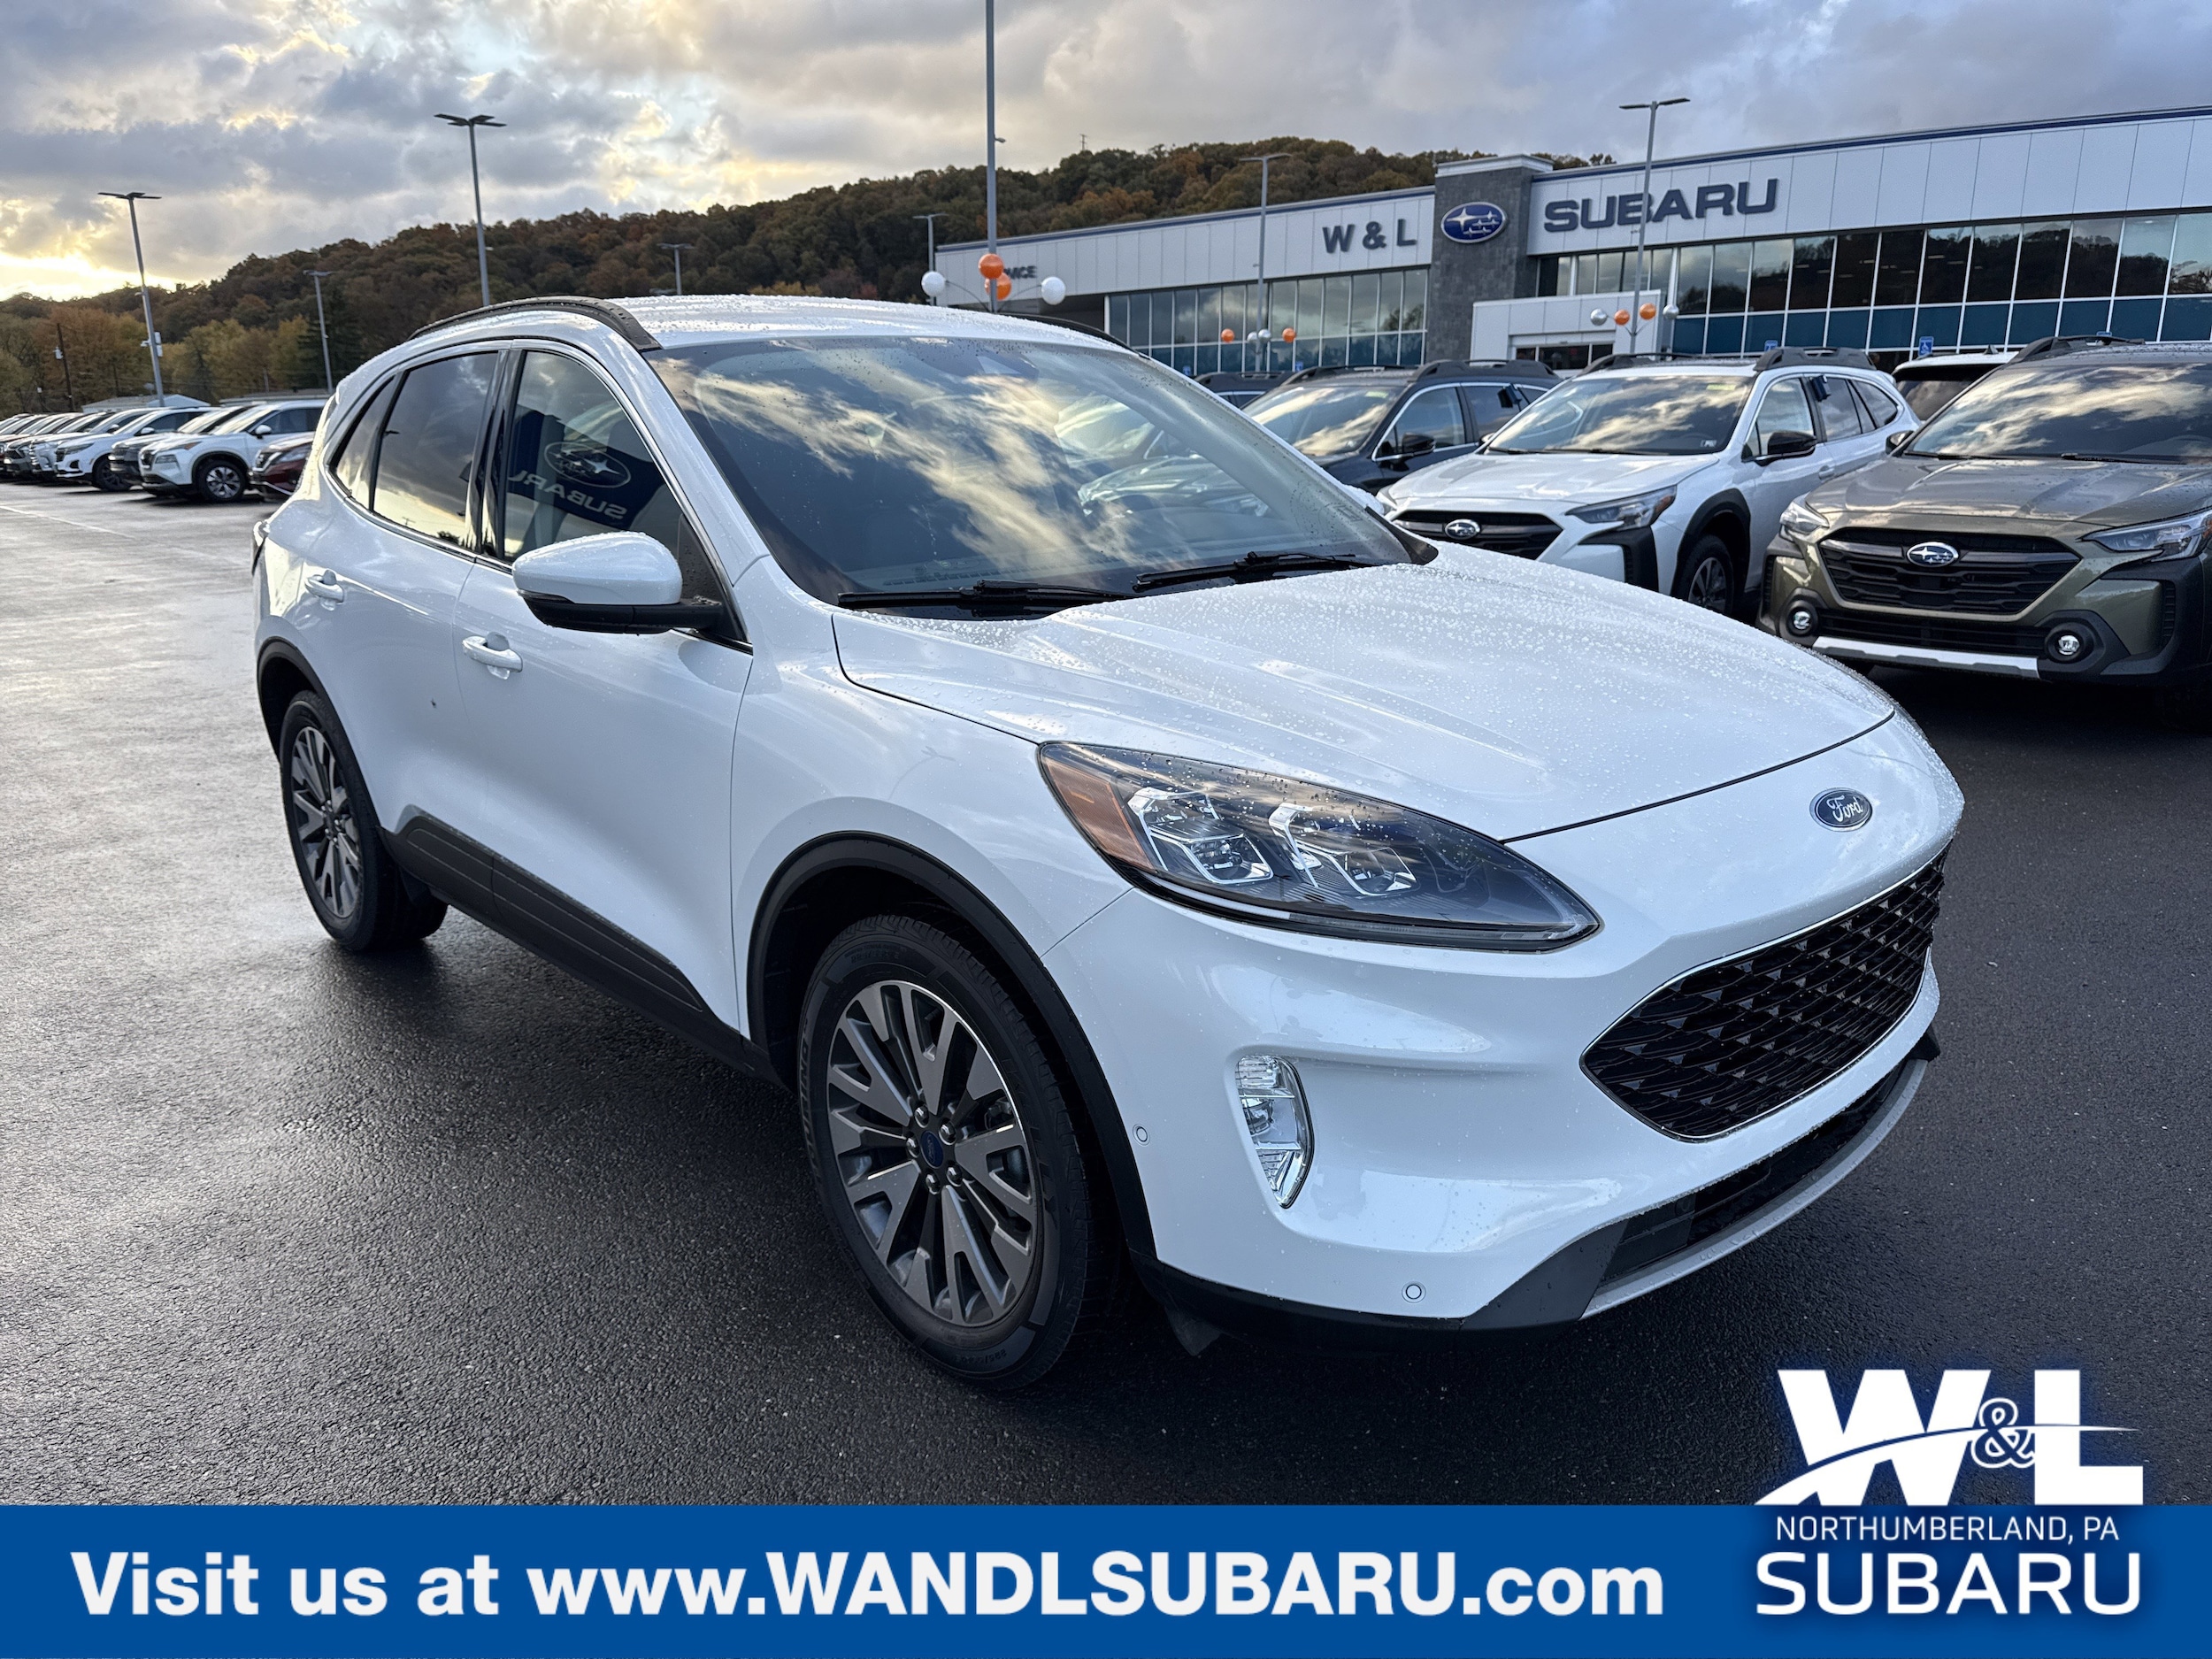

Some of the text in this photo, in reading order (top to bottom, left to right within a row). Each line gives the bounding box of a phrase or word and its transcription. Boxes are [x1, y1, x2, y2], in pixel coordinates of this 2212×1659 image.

[1544, 178, 1778, 234] SUBARU
[1322, 219, 1417, 254] W & L
[1826, 795, 1863, 822] Ford
